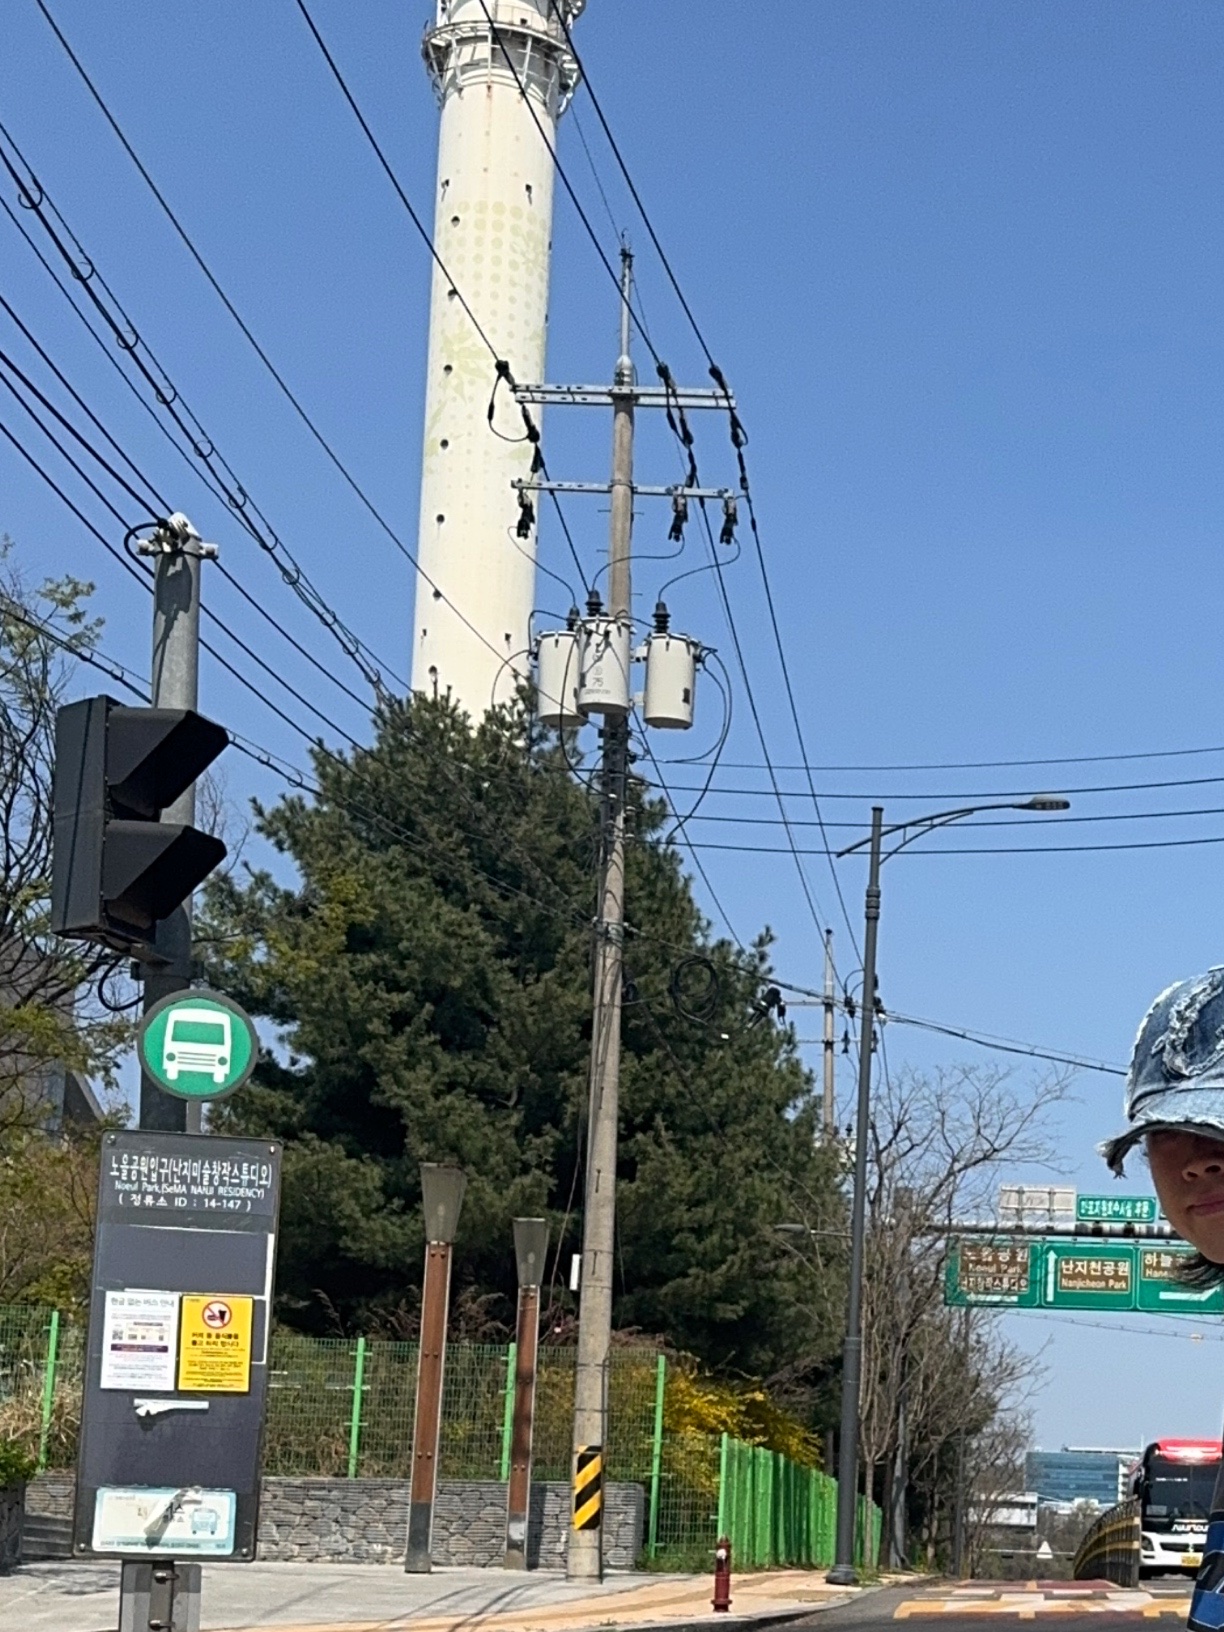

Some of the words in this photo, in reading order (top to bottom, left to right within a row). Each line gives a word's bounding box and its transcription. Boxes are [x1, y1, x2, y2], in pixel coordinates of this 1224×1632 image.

[115, 1180, 138, 1191] Noeul
[130, 1193, 168, 1206] 정류소
[174, 1197, 187, 1207] ID
[203, 1198, 241, 1209] 14-147
[1061, 1260, 1129, 1276] 난지천공원
[1061, 1278, 1106, 1289] Nanjicheon
[1108, 1279, 1127, 1289] Park
